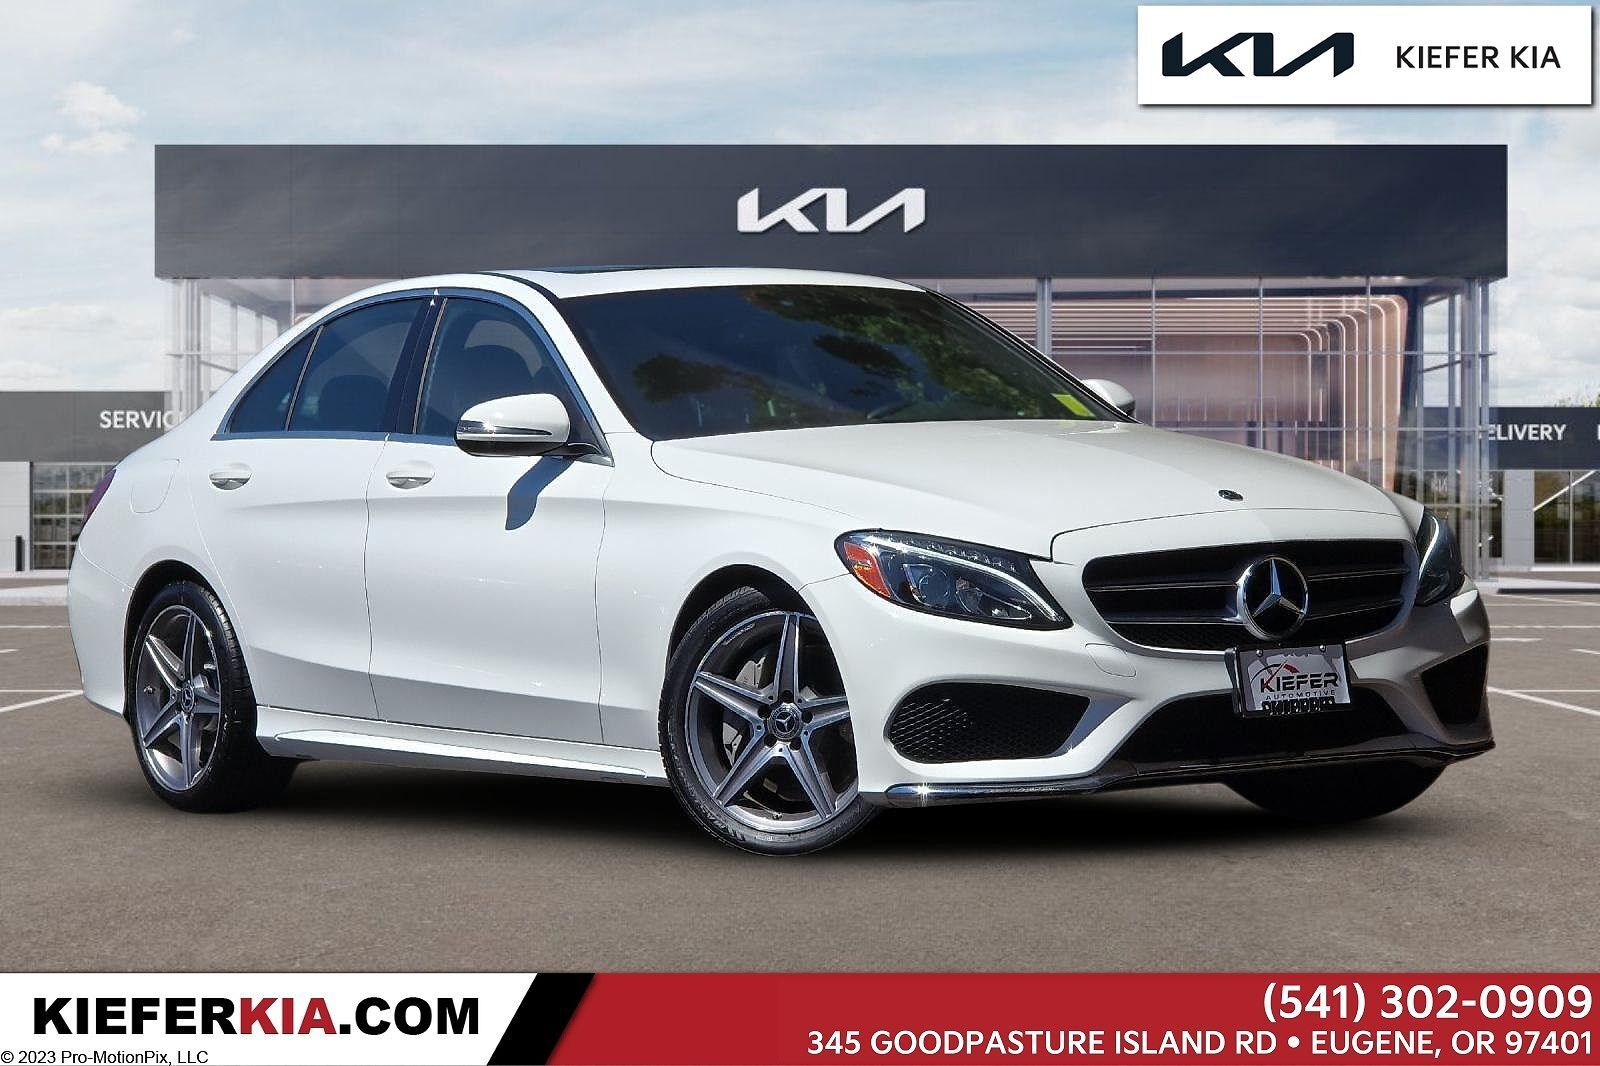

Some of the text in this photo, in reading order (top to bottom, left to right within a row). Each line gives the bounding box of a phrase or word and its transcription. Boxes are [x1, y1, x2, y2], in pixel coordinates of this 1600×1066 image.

[738, 188, 926, 233] KIA
[100, 409, 183, 430] SERVIC
[1260, 669, 1339, 693] KIEFER
[1265, 690, 1336, 701] AUTOMOTIVE
